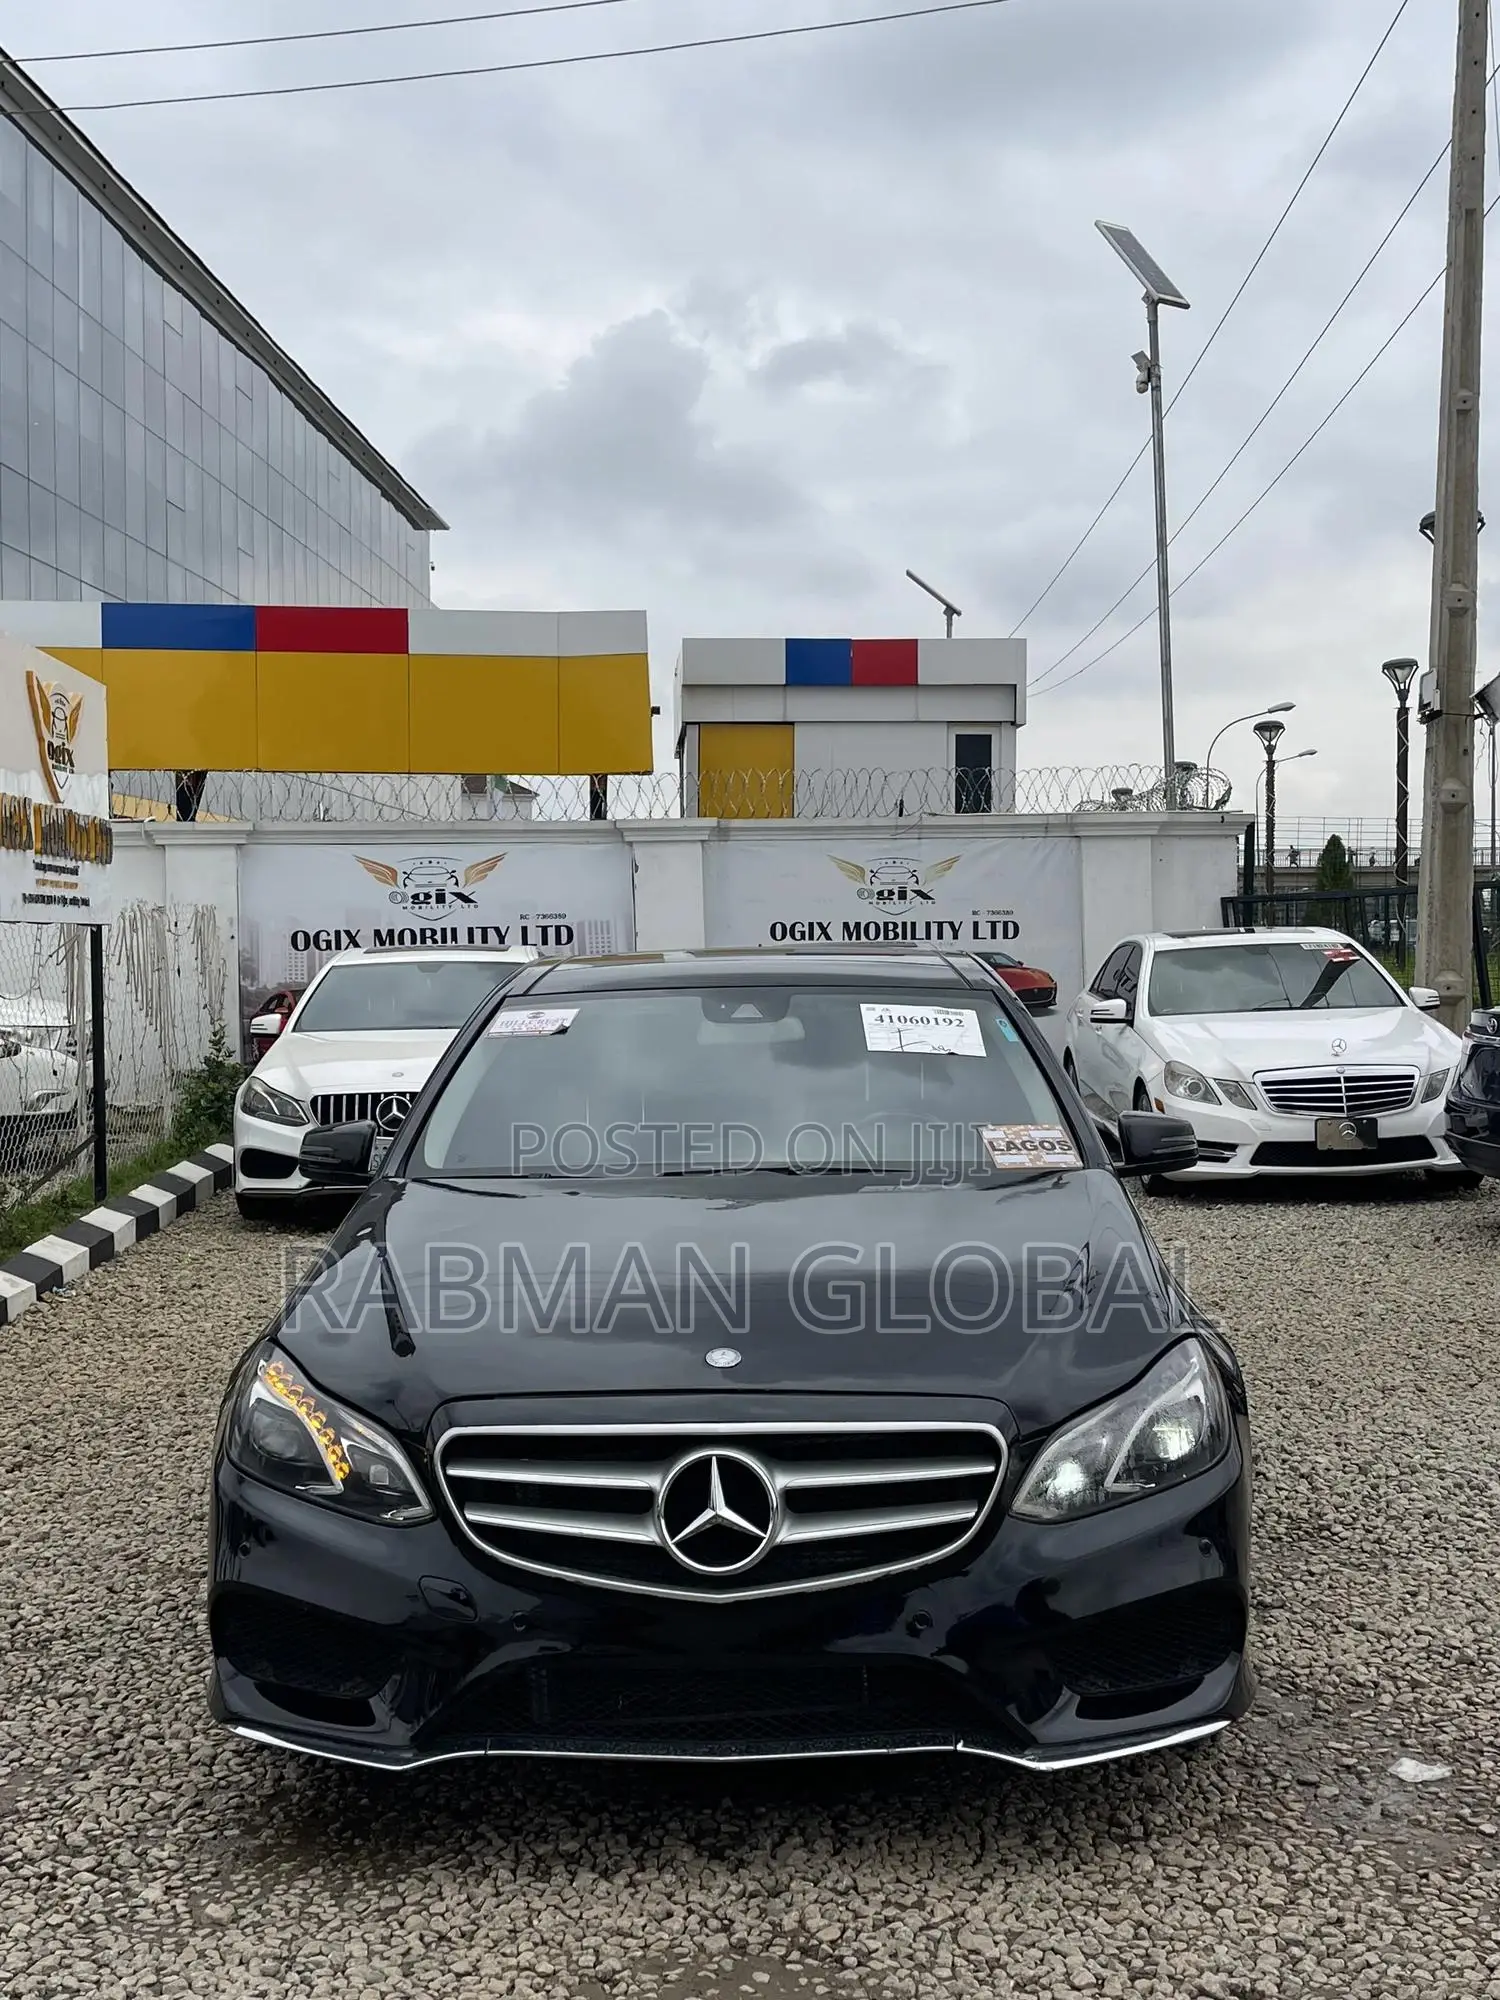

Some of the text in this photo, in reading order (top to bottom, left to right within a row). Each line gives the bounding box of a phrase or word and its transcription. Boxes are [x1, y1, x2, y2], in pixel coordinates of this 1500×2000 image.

[290, 929, 362, 952] OGIX
[520, 924, 574, 947] LTD
[769, 920, 1020, 942] OGIX MOBILITY LTD
[874, 1014, 965, 1028] 41060192
[987, 1140, 1073, 1152] LAGOS
